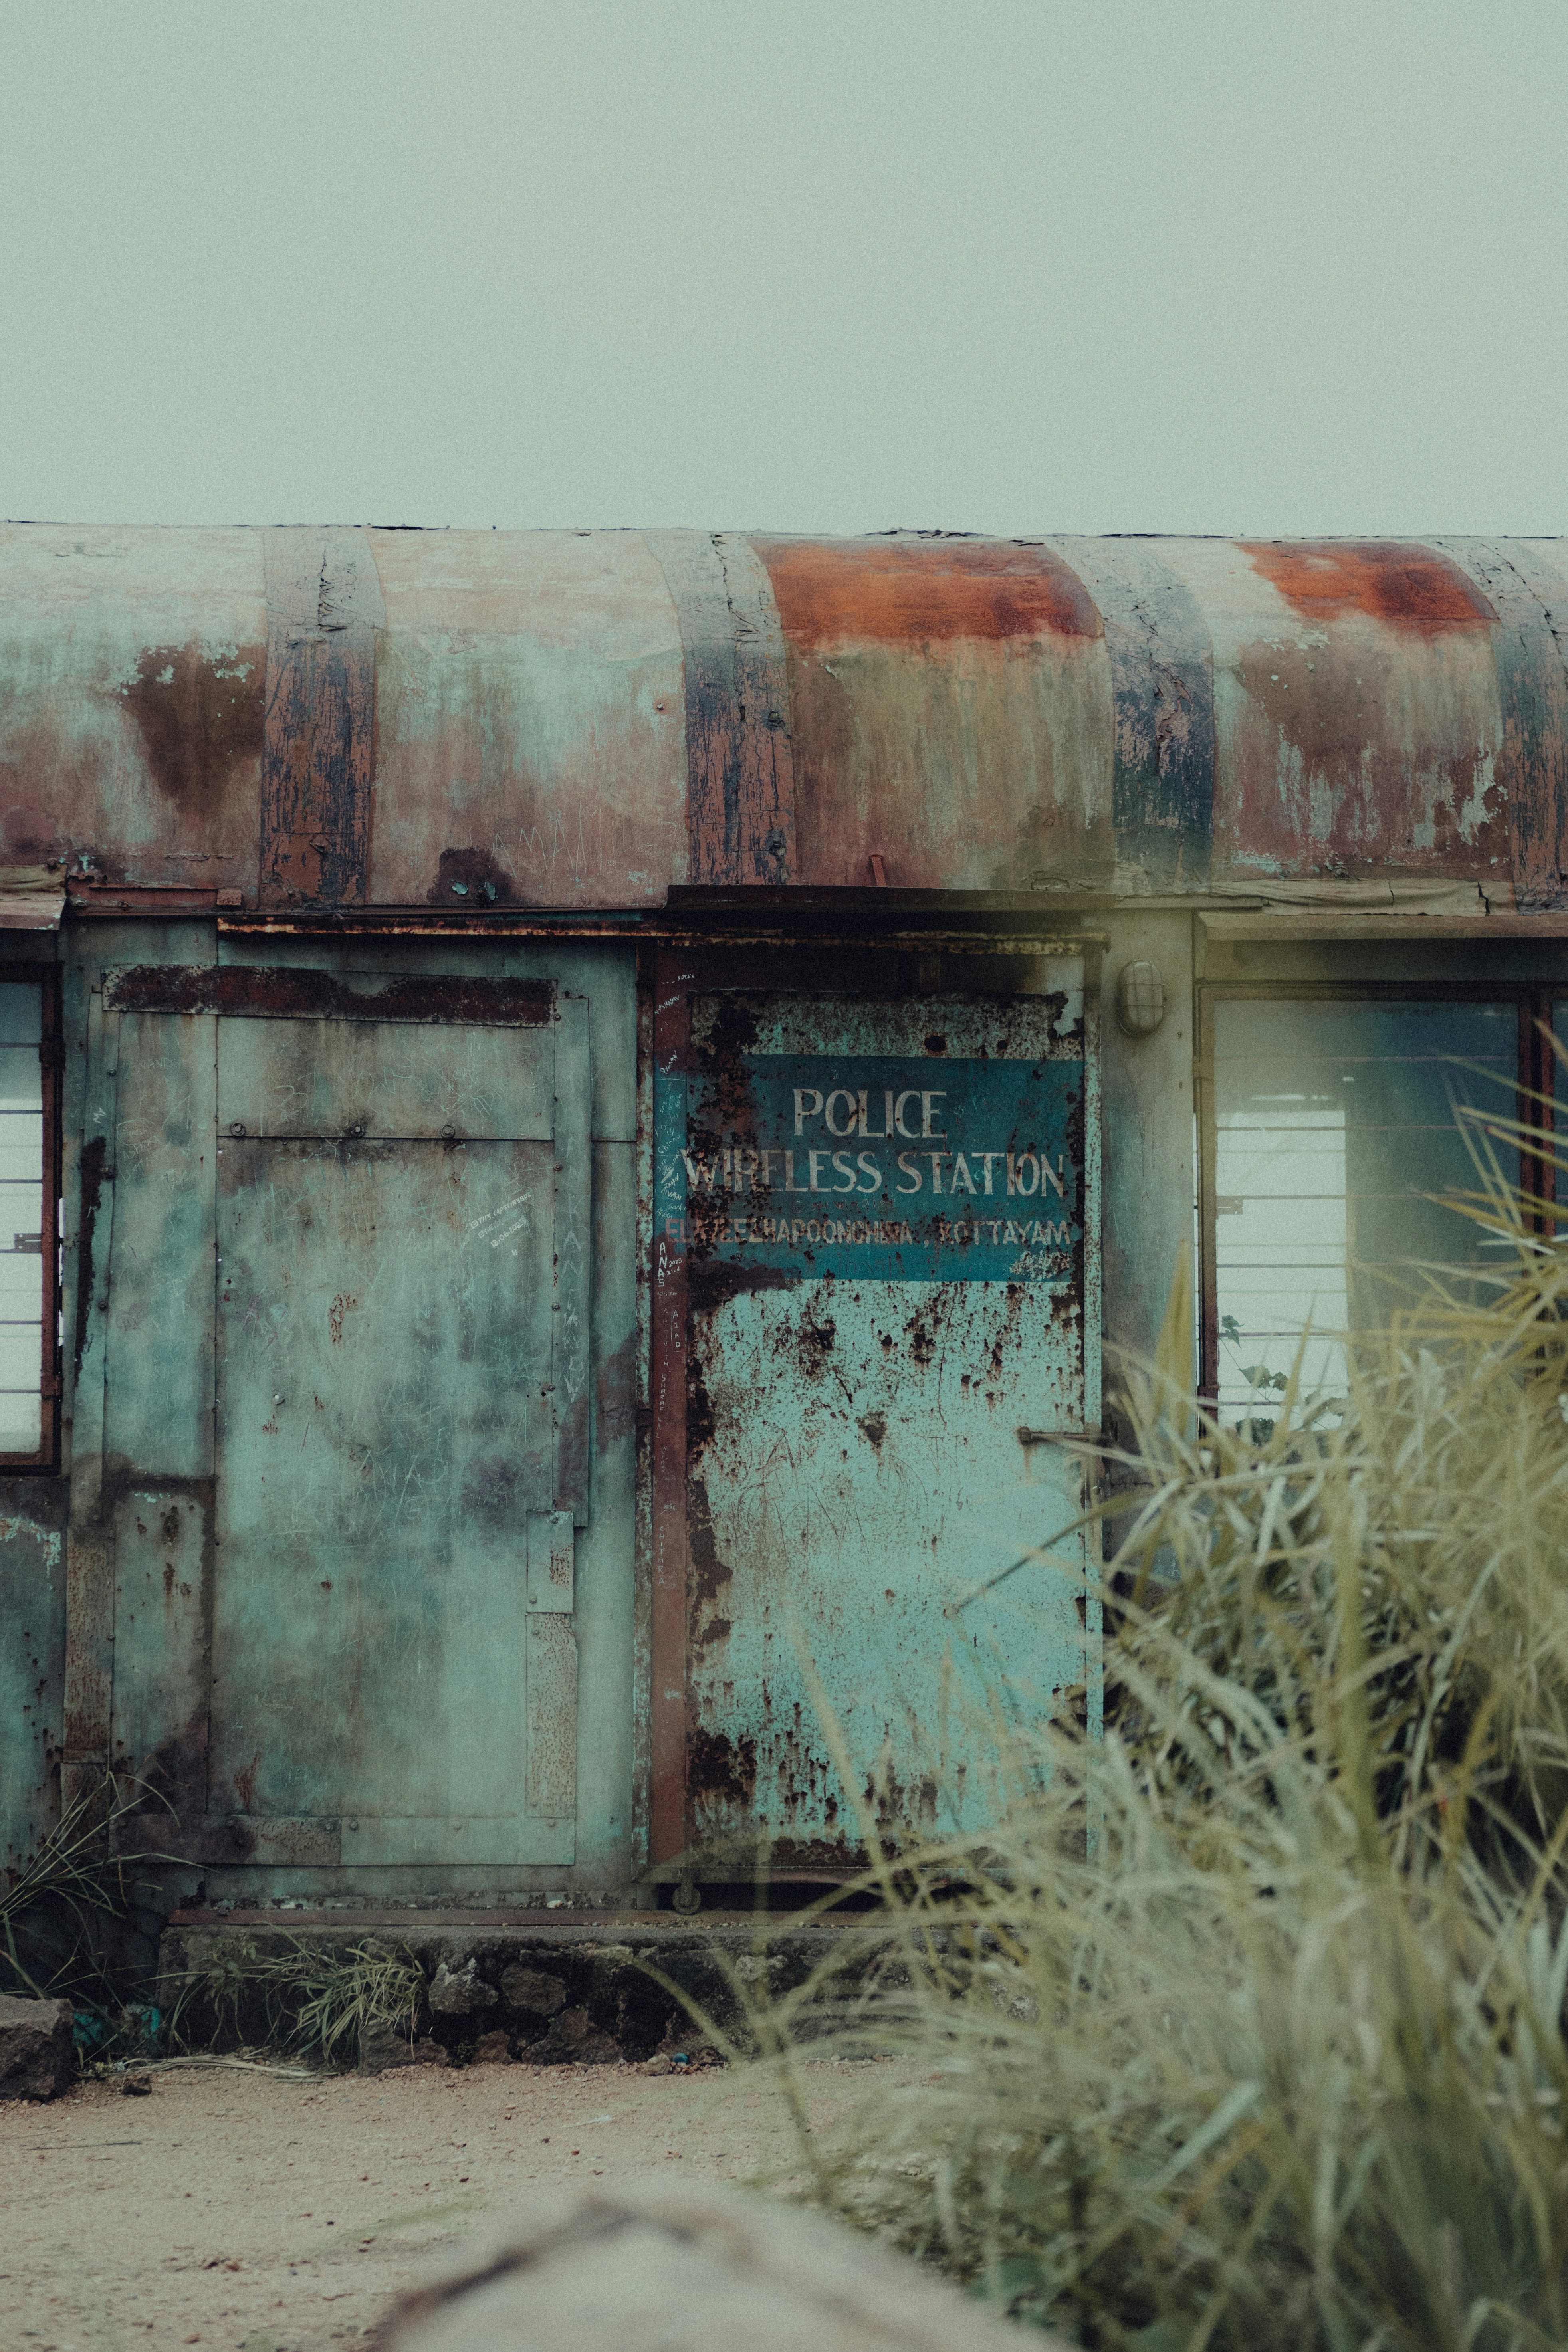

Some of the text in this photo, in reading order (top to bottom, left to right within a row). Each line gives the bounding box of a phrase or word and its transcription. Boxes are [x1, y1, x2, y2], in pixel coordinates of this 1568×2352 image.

[793, 1089, 947, 1138] POLICE
[680, 1149, 882, 1193] WIRELESS
[895, 1151, 1063, 1197] STATION
[939, 1220, 1070, 1245] KOTTAYAM
[669, 1258, 682, 1268] 2023
